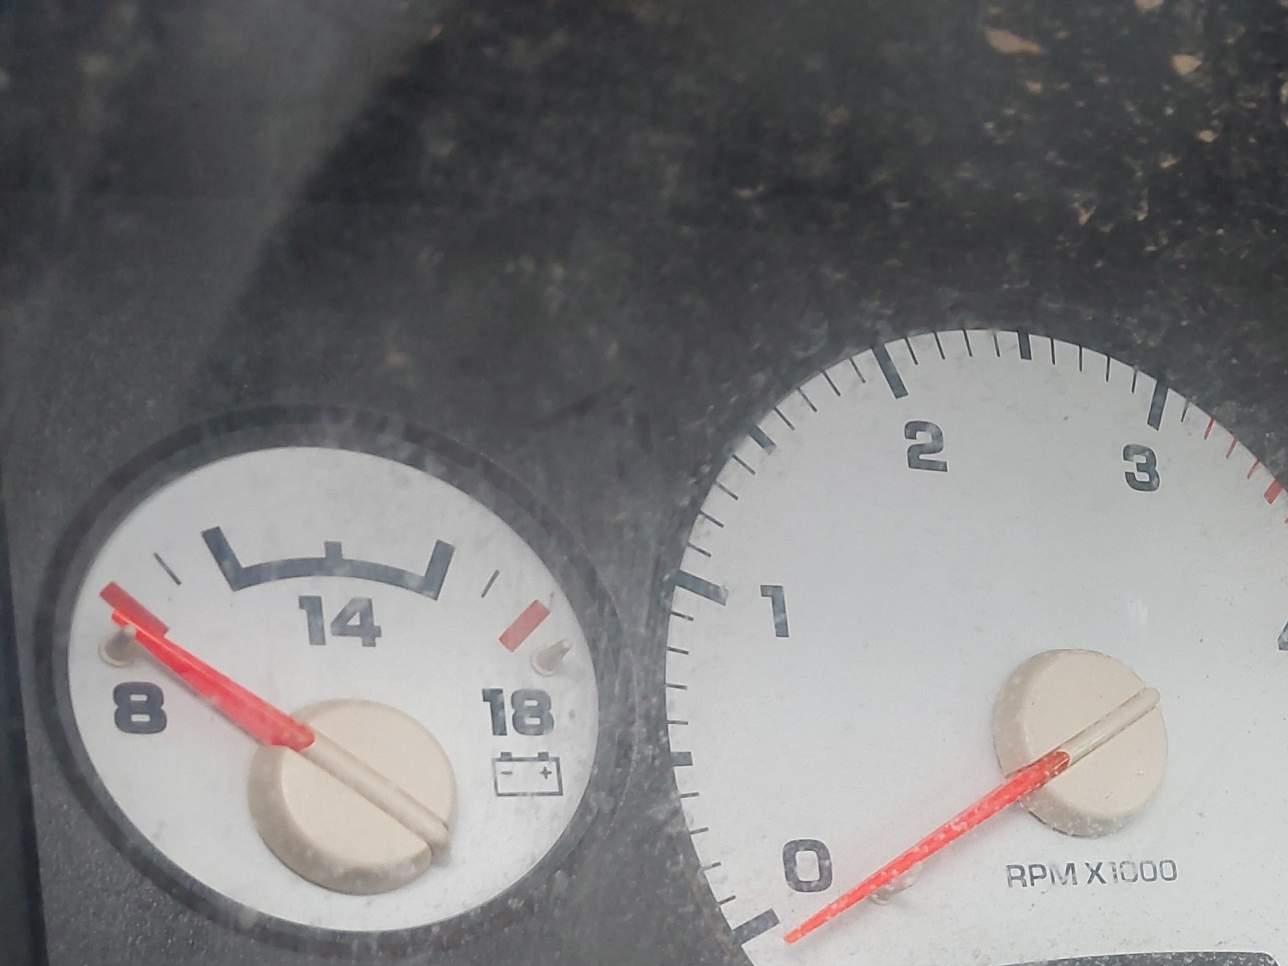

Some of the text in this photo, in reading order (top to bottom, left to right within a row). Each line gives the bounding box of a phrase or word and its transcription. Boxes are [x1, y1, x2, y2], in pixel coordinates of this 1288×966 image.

[903, 420, 949, 472] 2
[1122, 444, 1160, 491] 3
[299, 596, 382, 647] 14
[760, 584, 790, 638] 1
[112, 682, 168, 734] 8
[482, 689, 555, 736] 18
[782, 839, 833, 893] 0
[1006, 863, 1078, 888] RPM
